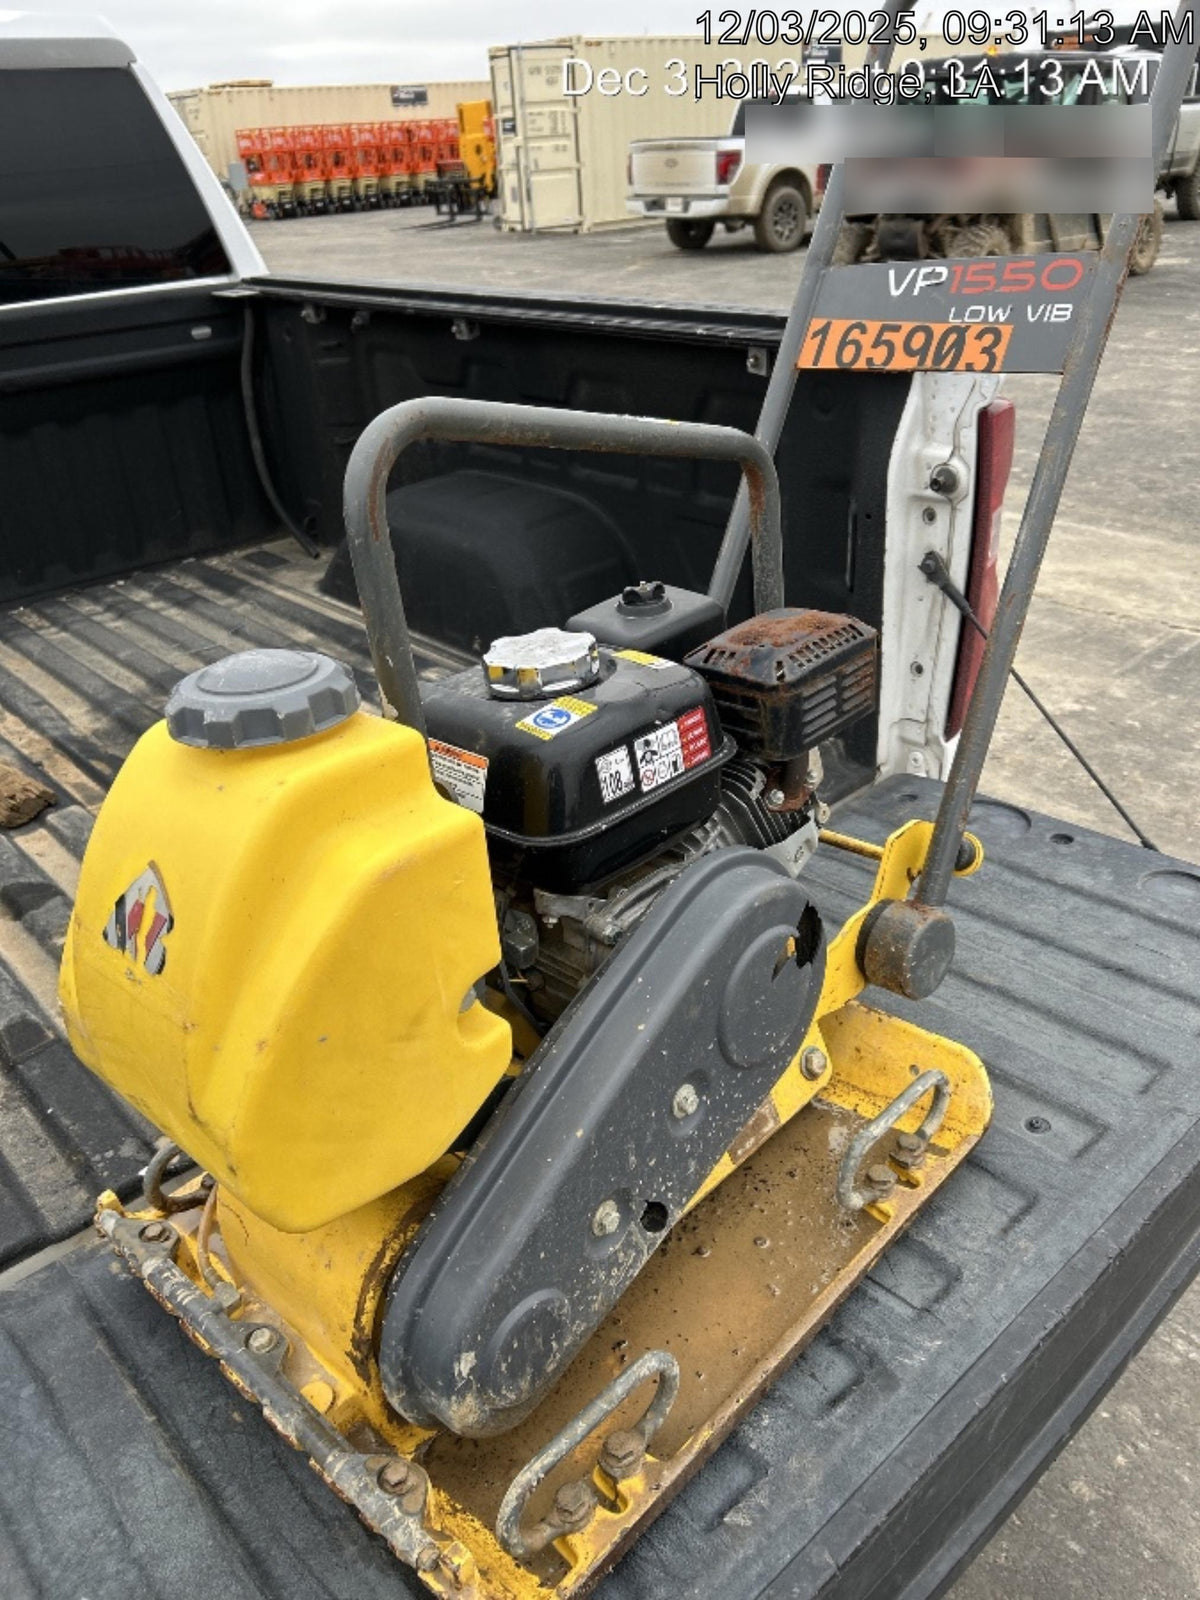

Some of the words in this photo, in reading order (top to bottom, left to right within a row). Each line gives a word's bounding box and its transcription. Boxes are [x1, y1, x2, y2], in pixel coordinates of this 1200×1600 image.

[888, 258, 1084, 297] VP1550
[949, 304, 1012, 323] LOW
[1026, 303, 1074, 322] VIB
[809, 320, 1003, 373] 165903
